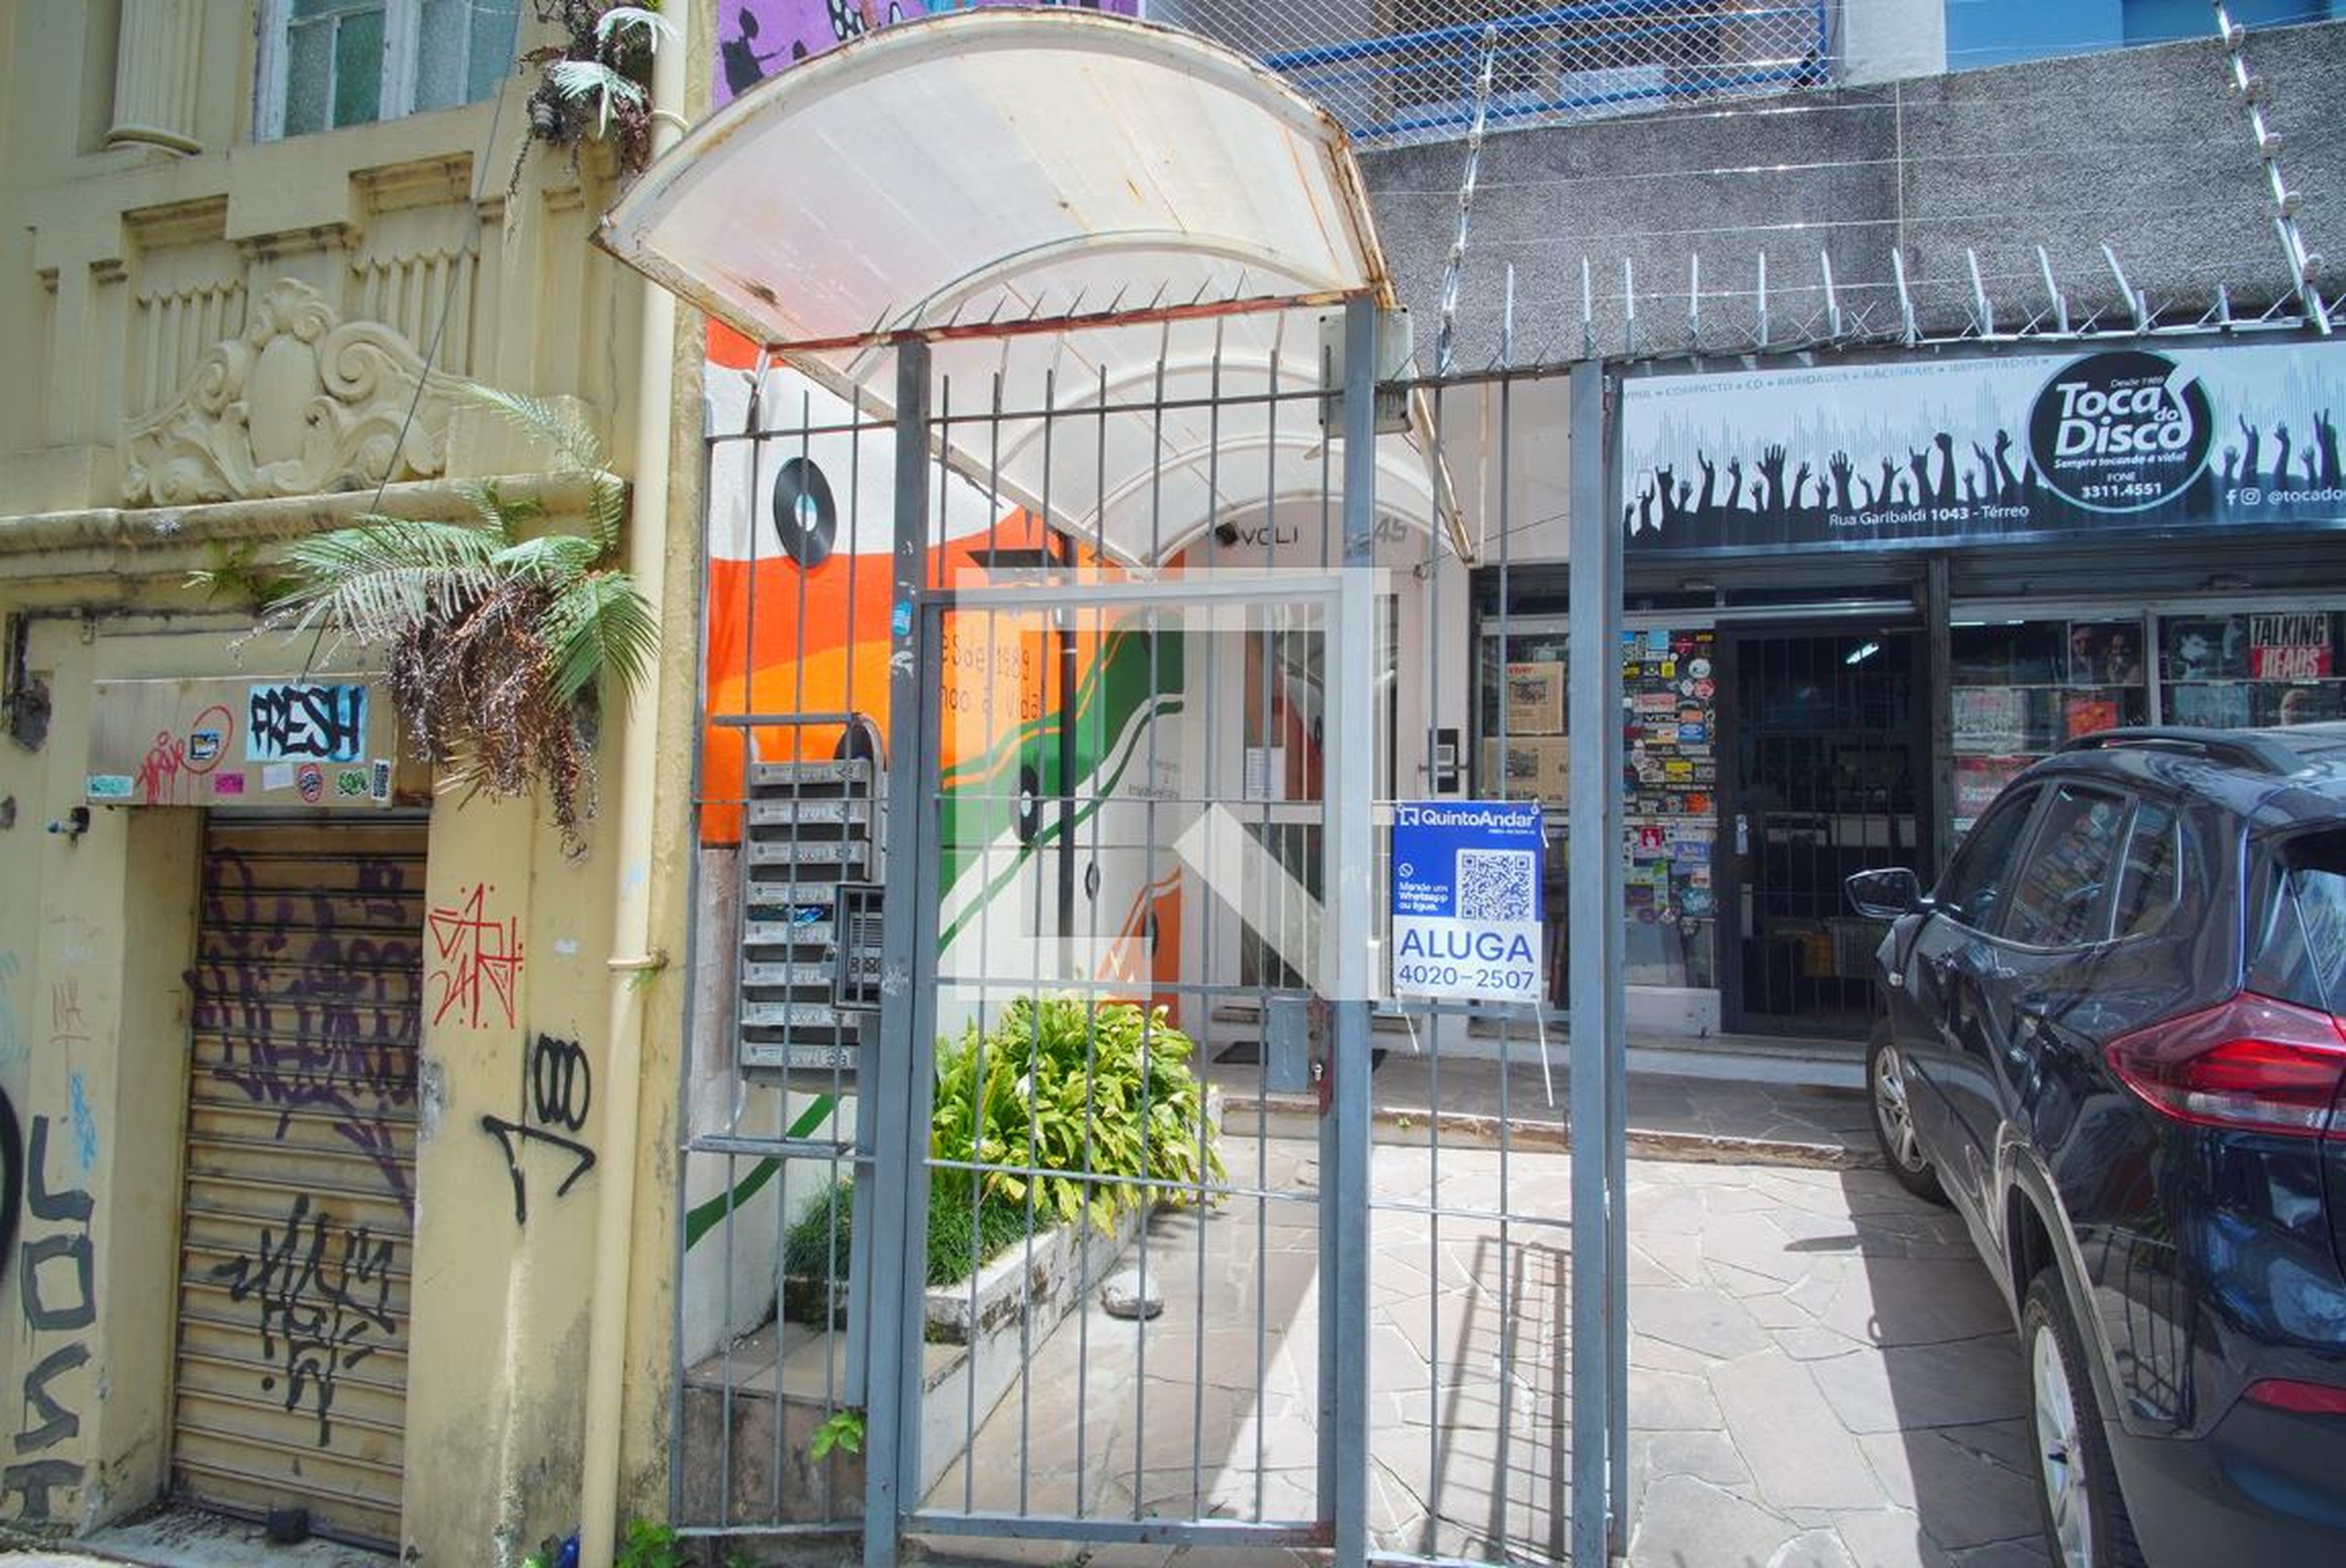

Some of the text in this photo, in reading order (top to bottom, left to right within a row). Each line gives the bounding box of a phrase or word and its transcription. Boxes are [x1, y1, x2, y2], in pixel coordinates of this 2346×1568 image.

[2056, 382, 2161, 418] Toca
[2153, 406, 2179, 421] do
[2055, 416, 2193, 456] Disco
[2054, 458, 2097, 470] Sempre
[2107, 471, 2136, 483] FONE
[2082, 483, 2162, 498] 3311.4551
[2267, 486, 2346, 505] @tocado
[1829, 513, 1857, 526] Rua
[1859, 509, 1926, 525] Garibaldi
[1931, 506, 1969, 521] 1043
[1981, 505, 2030, 519] Térreo
[2253, 615, 2324, 646] TALKING
[2260, 648, 2320, 679] HEADS
[250, 685, 361, 757] FRESH
[1421, 809, 1536, 827] QuintoAndar
[1400, 928, 1533, 963] ALUGA
[1399, 965, 1535, 990] 4020-2507
